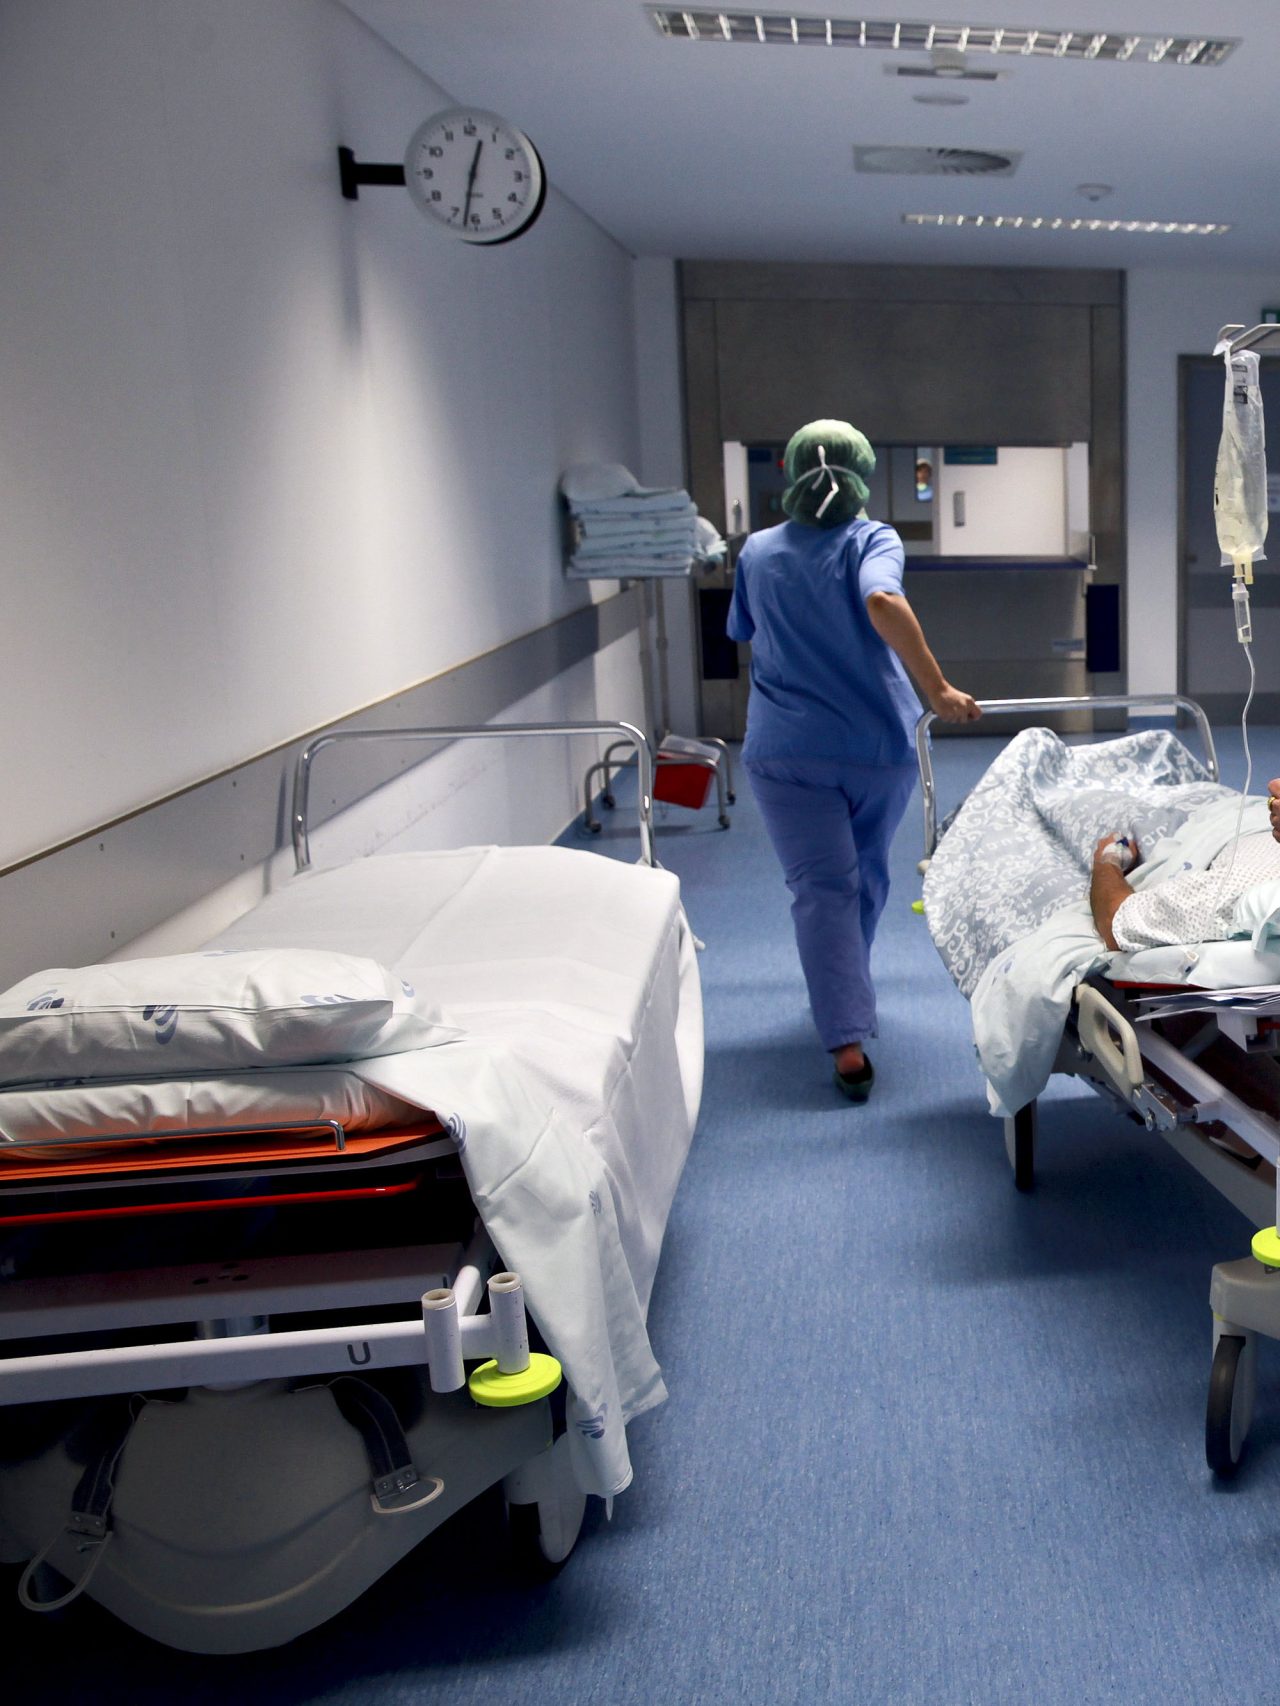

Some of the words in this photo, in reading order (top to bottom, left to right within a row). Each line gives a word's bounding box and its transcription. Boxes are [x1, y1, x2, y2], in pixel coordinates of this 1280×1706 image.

[463, 124, 477, 137] 12
[492, 133, 498, 143] 1
[428, 146, 443, 158] 10
[505, 148, 515, 160] 2
[423, 168, 434, 180] 9
[514, 170, 523, 183] 3
[431, 190, 442, 202] 8
[507, 192, 517, 203] 4
[450, 206, 460, 218] 7
[491, 207, 502, 220] 5
[470, 213, 481, 226] 6
[347, 1341, 371, 1366] U
